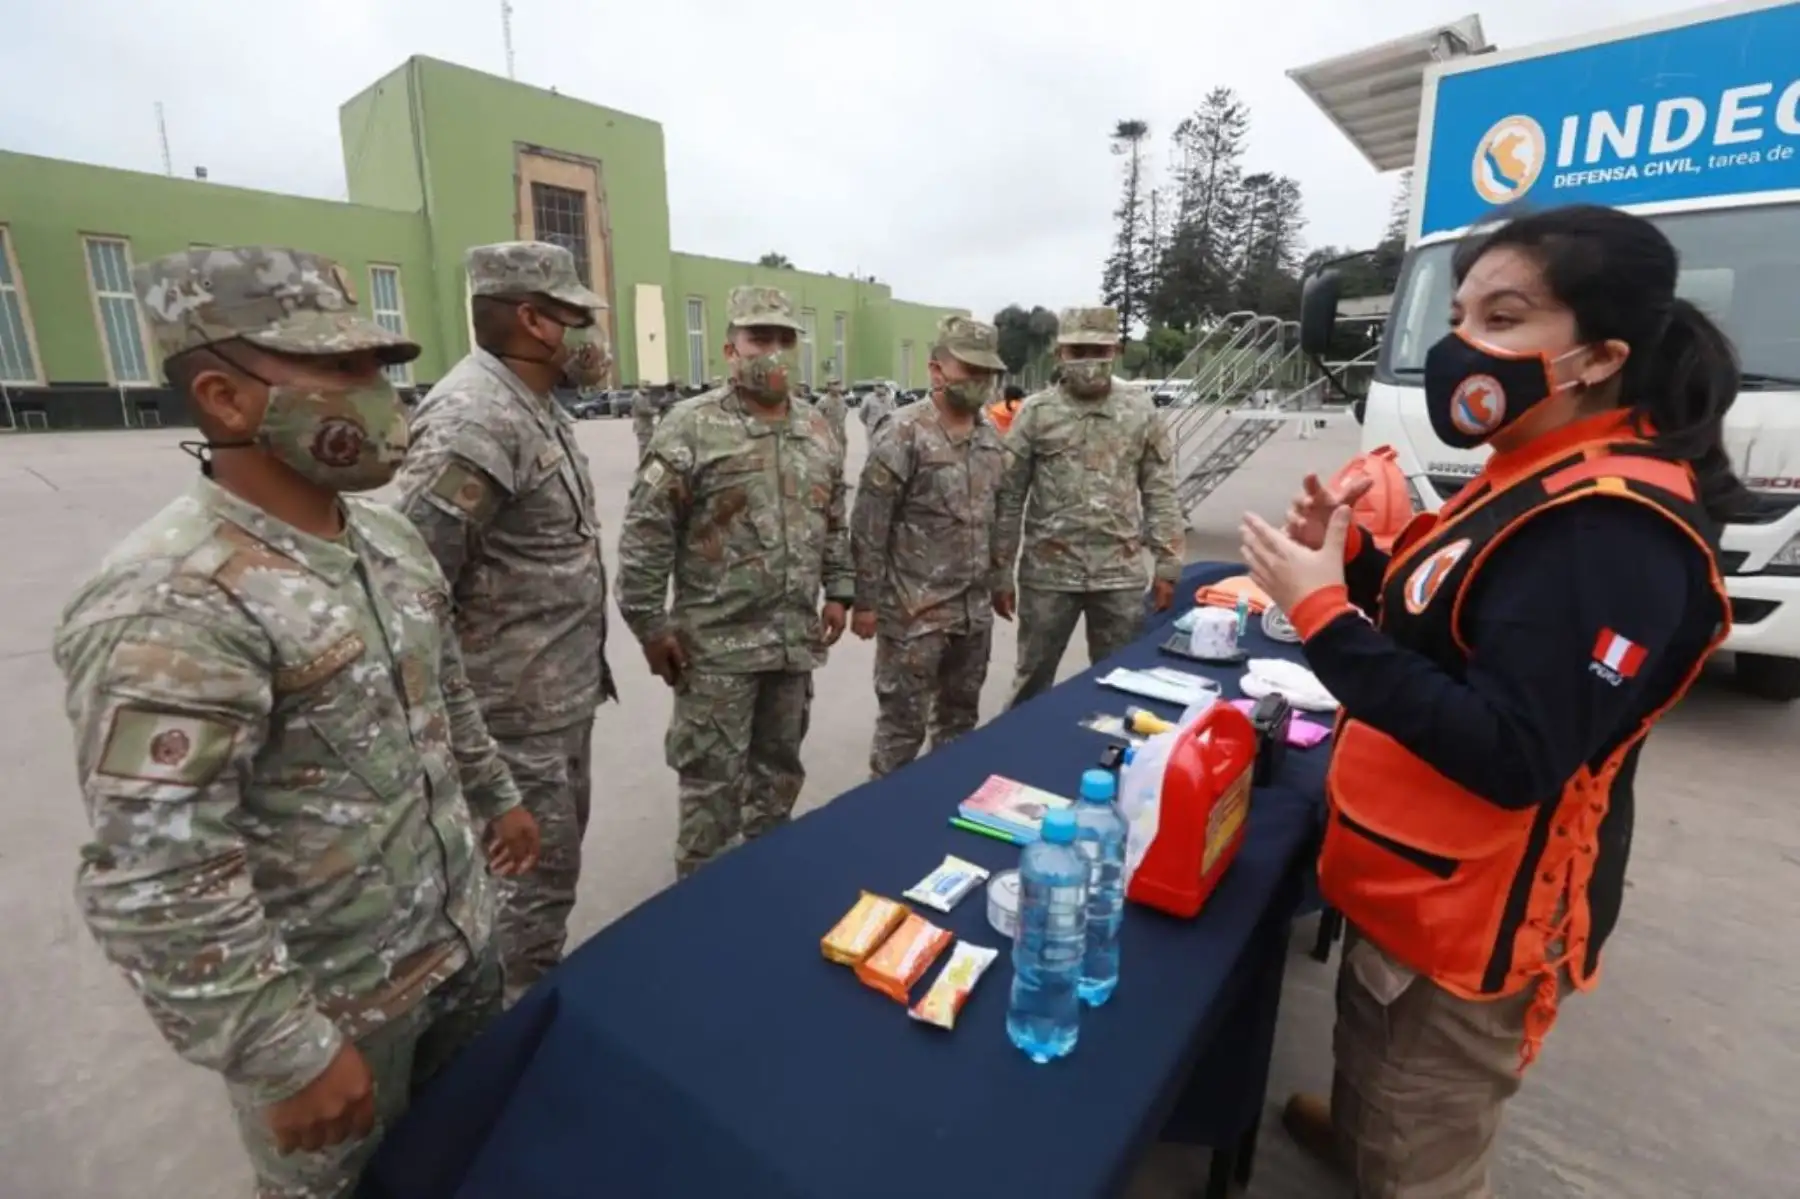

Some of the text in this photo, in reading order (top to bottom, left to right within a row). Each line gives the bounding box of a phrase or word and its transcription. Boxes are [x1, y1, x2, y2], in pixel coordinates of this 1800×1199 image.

[1553, 144, 1795, 189] DEFENSA CIVIL, tarea de
